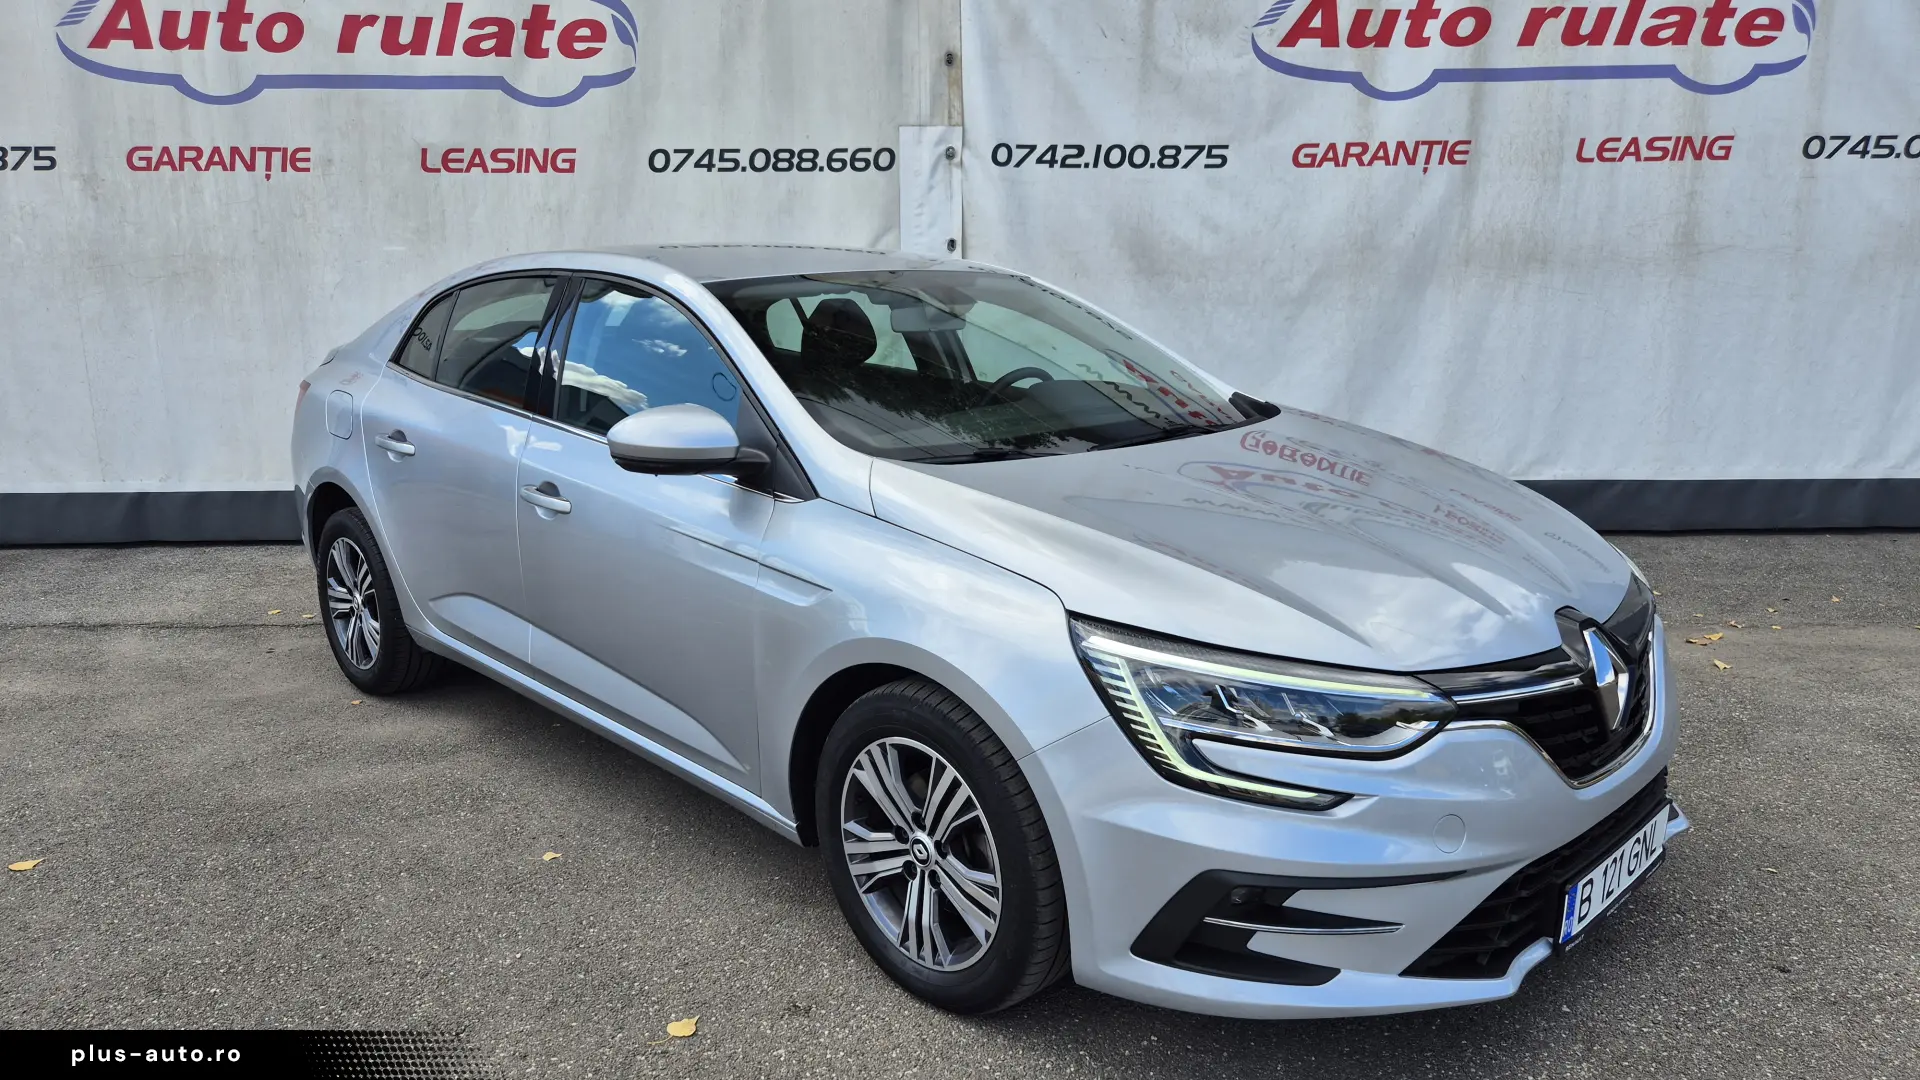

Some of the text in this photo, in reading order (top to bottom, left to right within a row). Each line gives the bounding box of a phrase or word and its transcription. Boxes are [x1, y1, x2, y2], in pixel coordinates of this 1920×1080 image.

[86, 0, 609, 60] Auto rulate
[1276, 0, 1787, 49] Auto rulate
[420, 147, 577, 175] LEASING
[648, 147, 896, 173] 0745.088.660
[991, 142, 1229, 170] 0742.100.875
[1575, 135, 1735, 164] LEASING
[1577, 877, 1594, 925] B
[1600, 848, 1625, 904] 121
[1627, 819, 1658, 877] GNL
